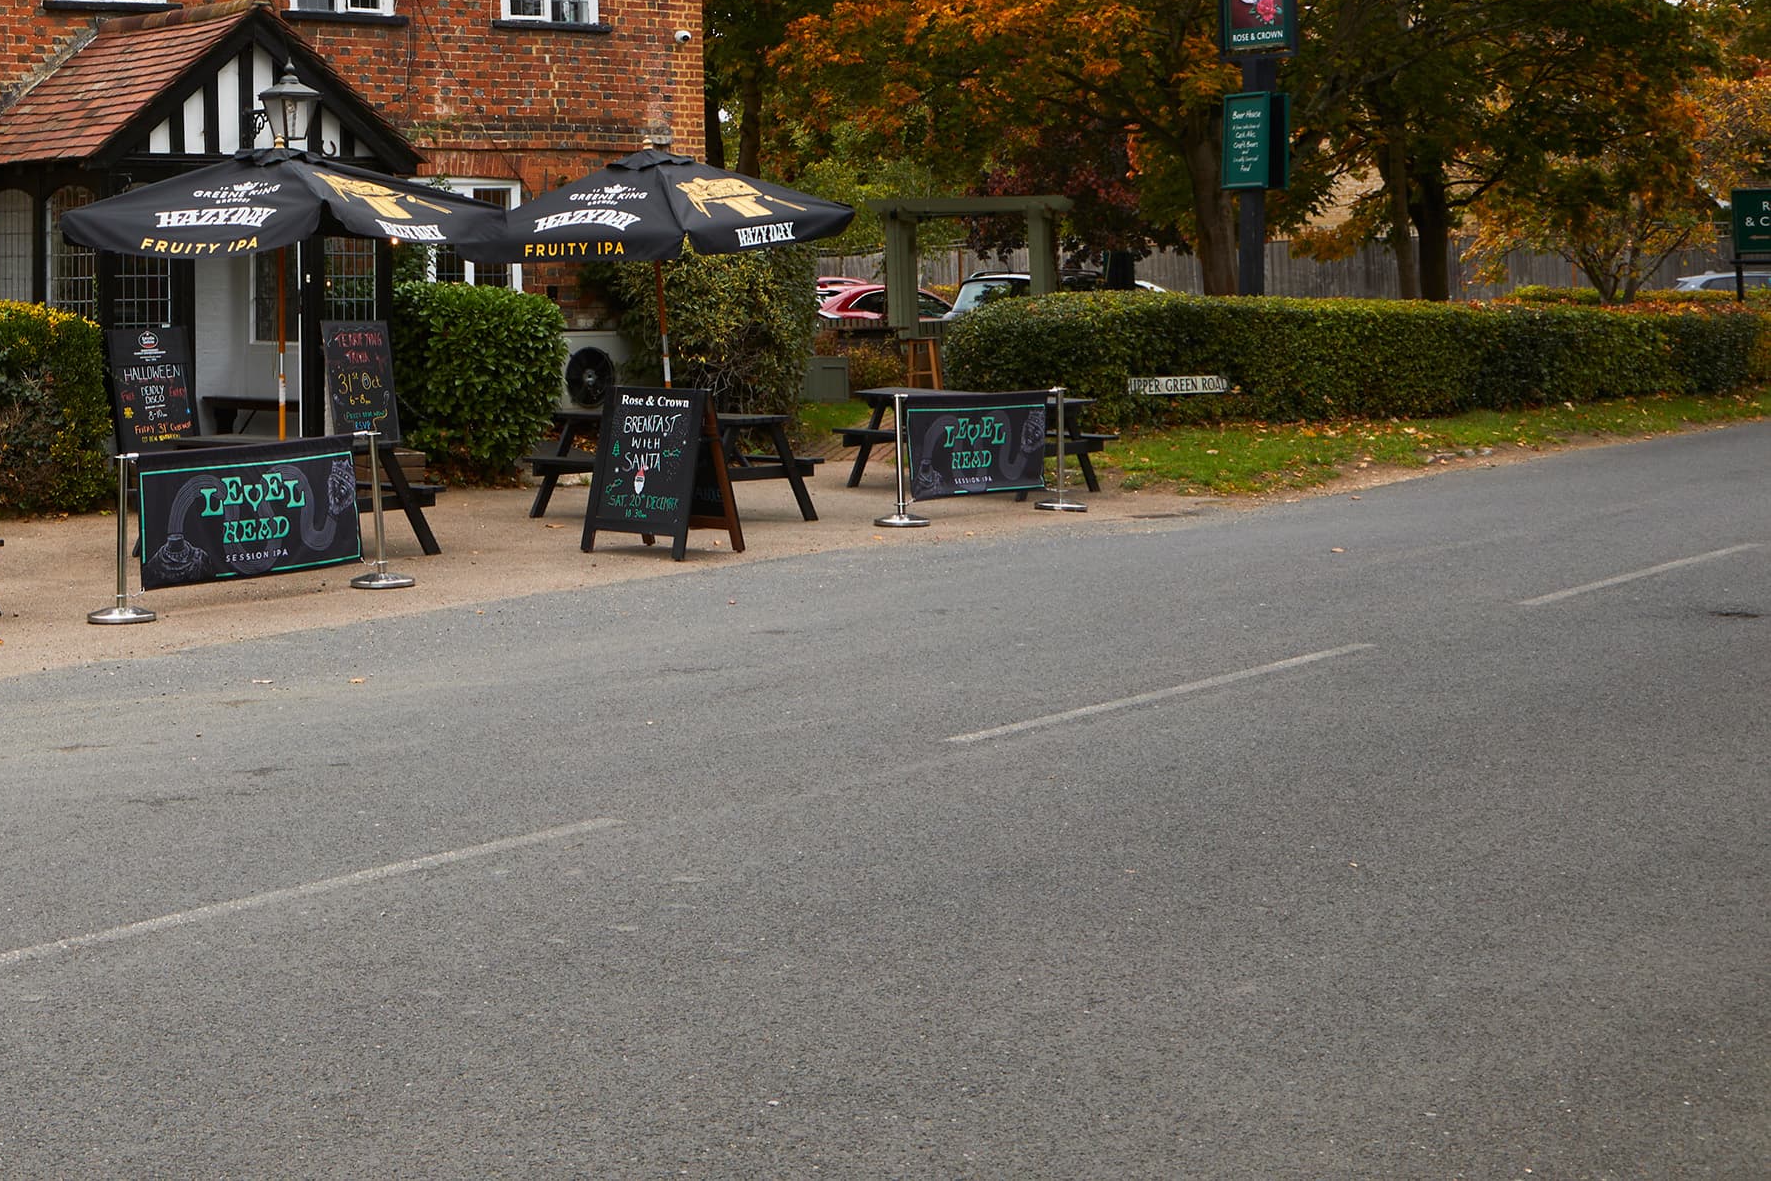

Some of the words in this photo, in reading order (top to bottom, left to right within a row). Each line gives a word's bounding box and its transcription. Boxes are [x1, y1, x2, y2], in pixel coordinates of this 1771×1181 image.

[1232, 33, 1249, 42] ROSE
[1250, 32, 1256, 41] &
[1256, 30, 1284, 40] CROWN
[192, 189, 245, 200] GREENE
[248, 183, 282, 197] KING
[569, 192, 616, 201] GREENE
[616, 191, 648, 200] KING
[1745, 216, 1755, 227] &
[140, 237, 221, 255] FRUITY
[227, 236, 259, 252] IPA
[524, 242, 589, 258] FRUITY
[597, 241, 625, 255] IPA
[123, 364, 181, 382] HALLOWEEN
[361, 371, 383, 390] Oct
[140, 385, 165, 397] DEADLY
[1129, 378, 1161, 394] UPPER
[1164, 377, 1199, 393] GREEN
[145, 394, 166, 405] DISCO
[621, 394, 644, 406] Rose
[645, 395, 655, 407] &
[657, 396, 690, 408] Crown
[354, 420, 372, 431] RSVP
[623, 413, 682, 434] BREAKFAST
[943, 416, 1007, 448] LEVEL
[622, 451, 661, 472] SANTA
[951, 450, 993, 470] HEAD
[200, 472, 305, 516] LEVEL
[645, 495, 679, 511] DECEMBER
[222, 515, 291, 544] HEAD
[225, 551, 269, 562] SESSION
[273, 548, 289, 557] IPA
